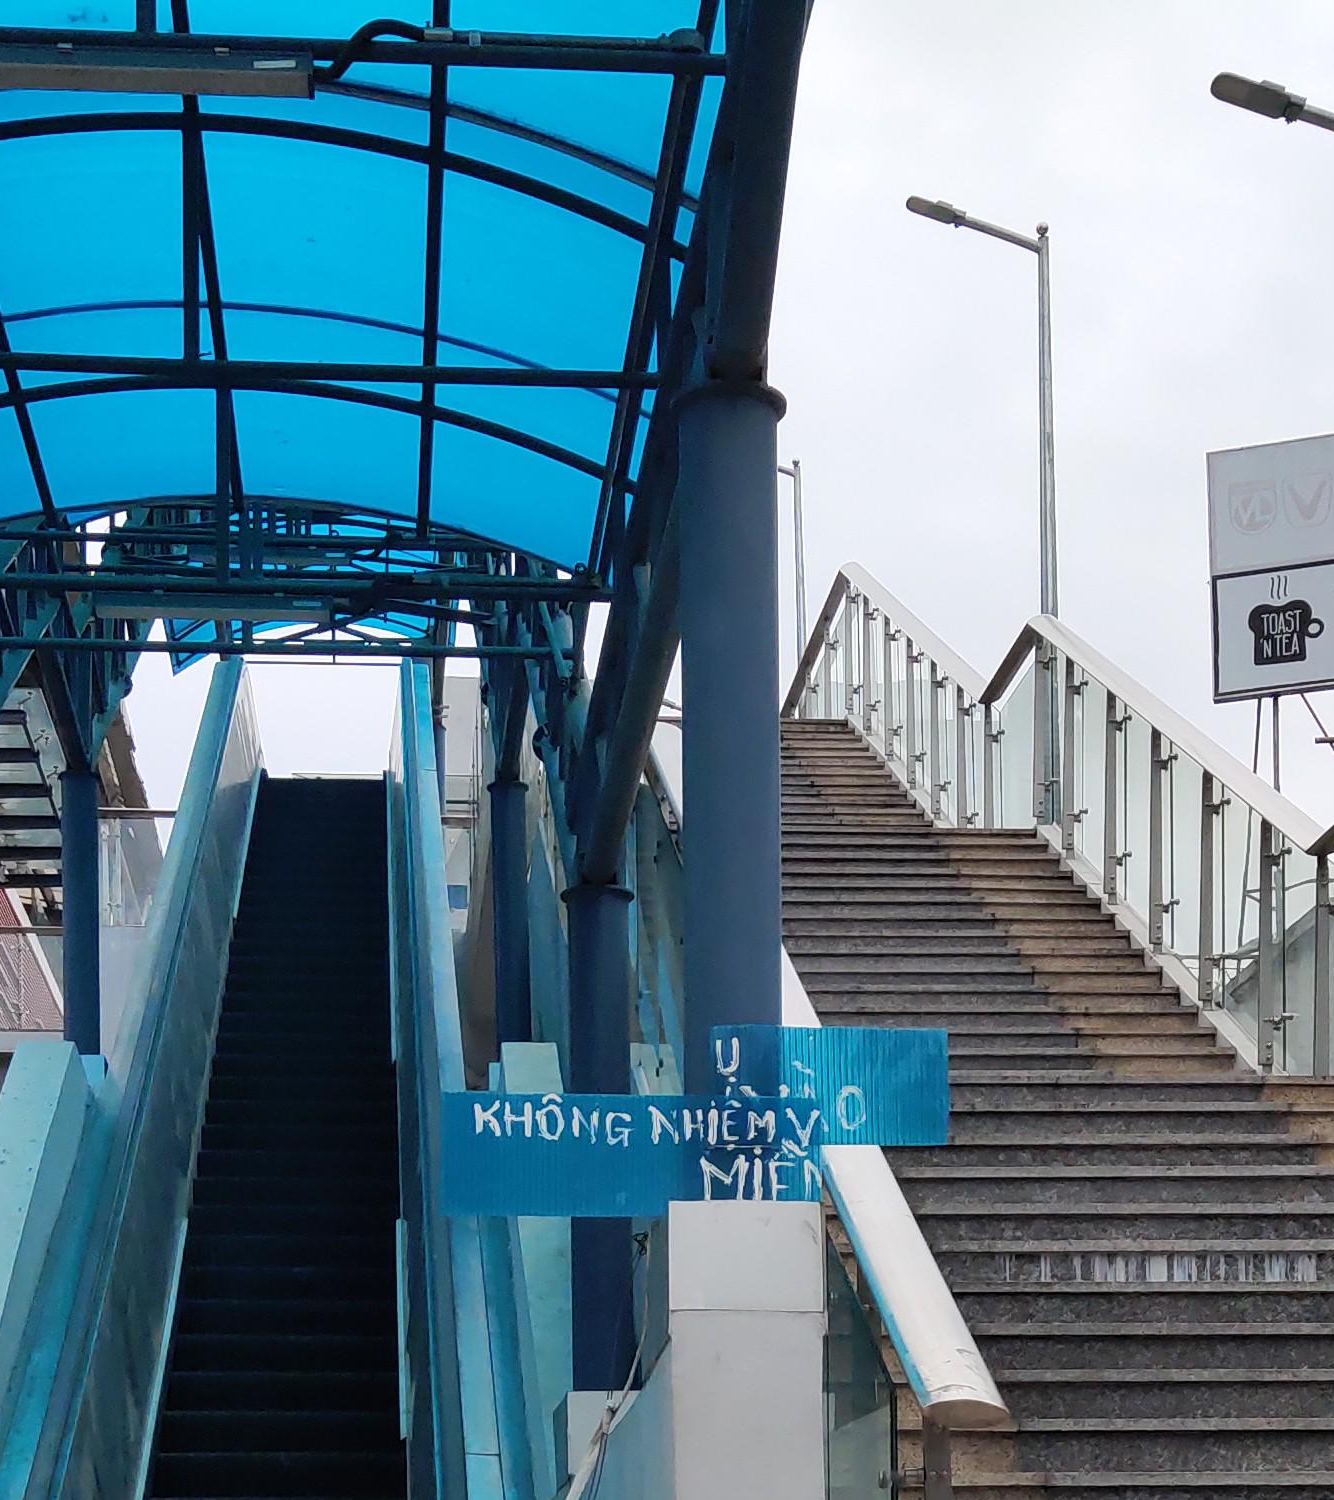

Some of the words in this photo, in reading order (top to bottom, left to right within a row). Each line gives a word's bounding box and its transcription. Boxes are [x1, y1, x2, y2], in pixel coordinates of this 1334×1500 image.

[1261, 608, 1303, 637] TOAST
[1274, 631, 1301, 658] TEA
[472, 1093, 637, 1149] KHÔNG
